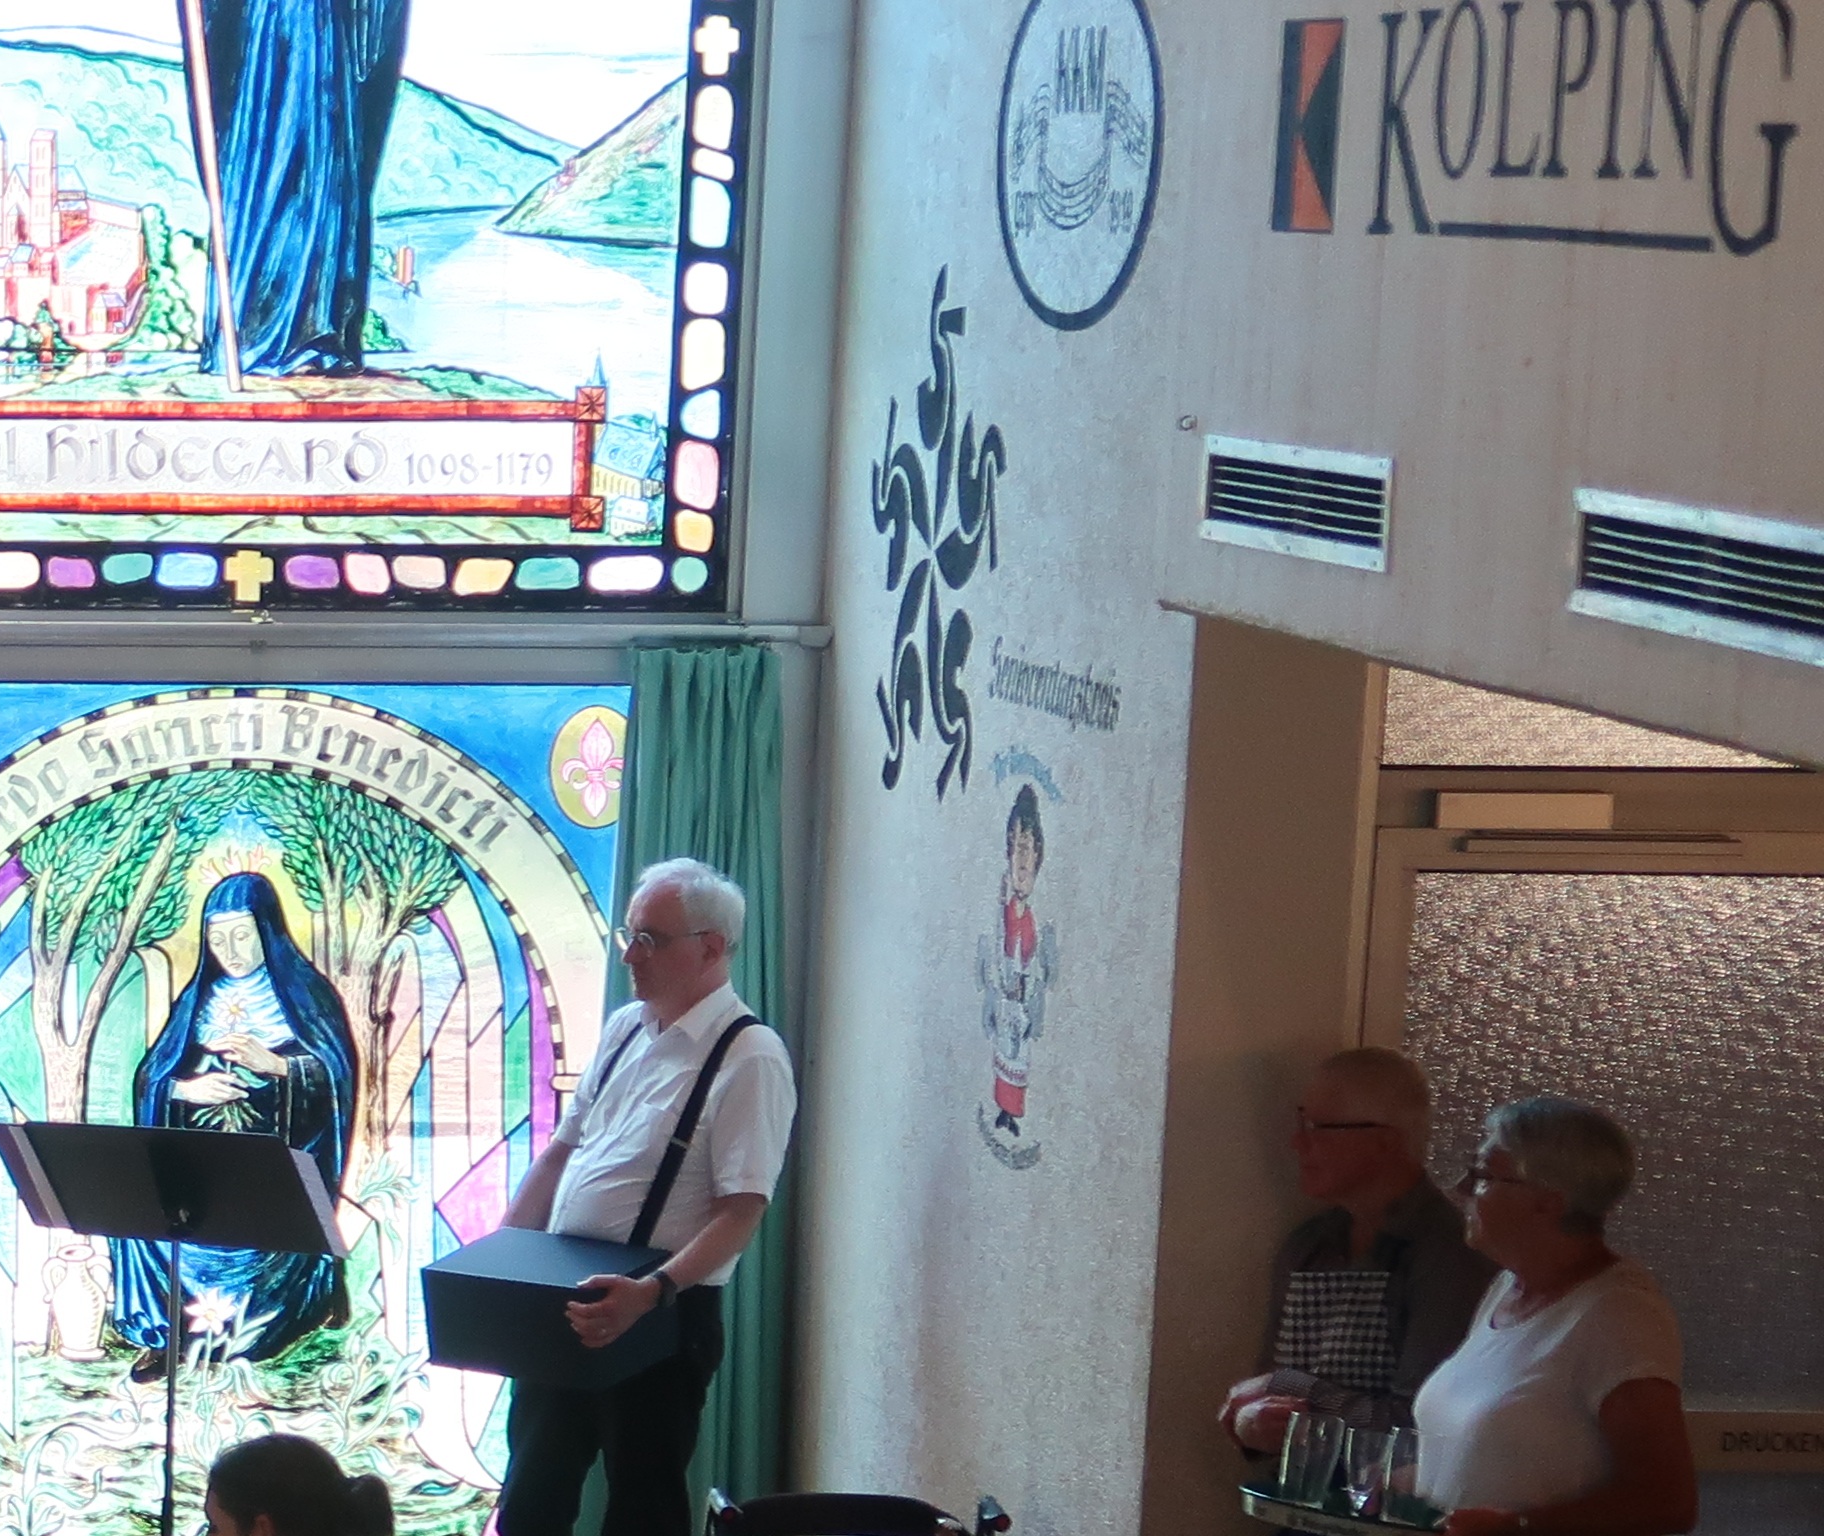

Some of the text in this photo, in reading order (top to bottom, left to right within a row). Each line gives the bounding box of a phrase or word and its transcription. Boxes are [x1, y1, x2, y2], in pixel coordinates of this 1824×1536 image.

[1366, 0, 1798, 256] KOLPING
[405, 450, 553, 486] 1098-1179
[78, 704, 264, 779] Sancti
[280, 704, 518, 853] Benedicti
